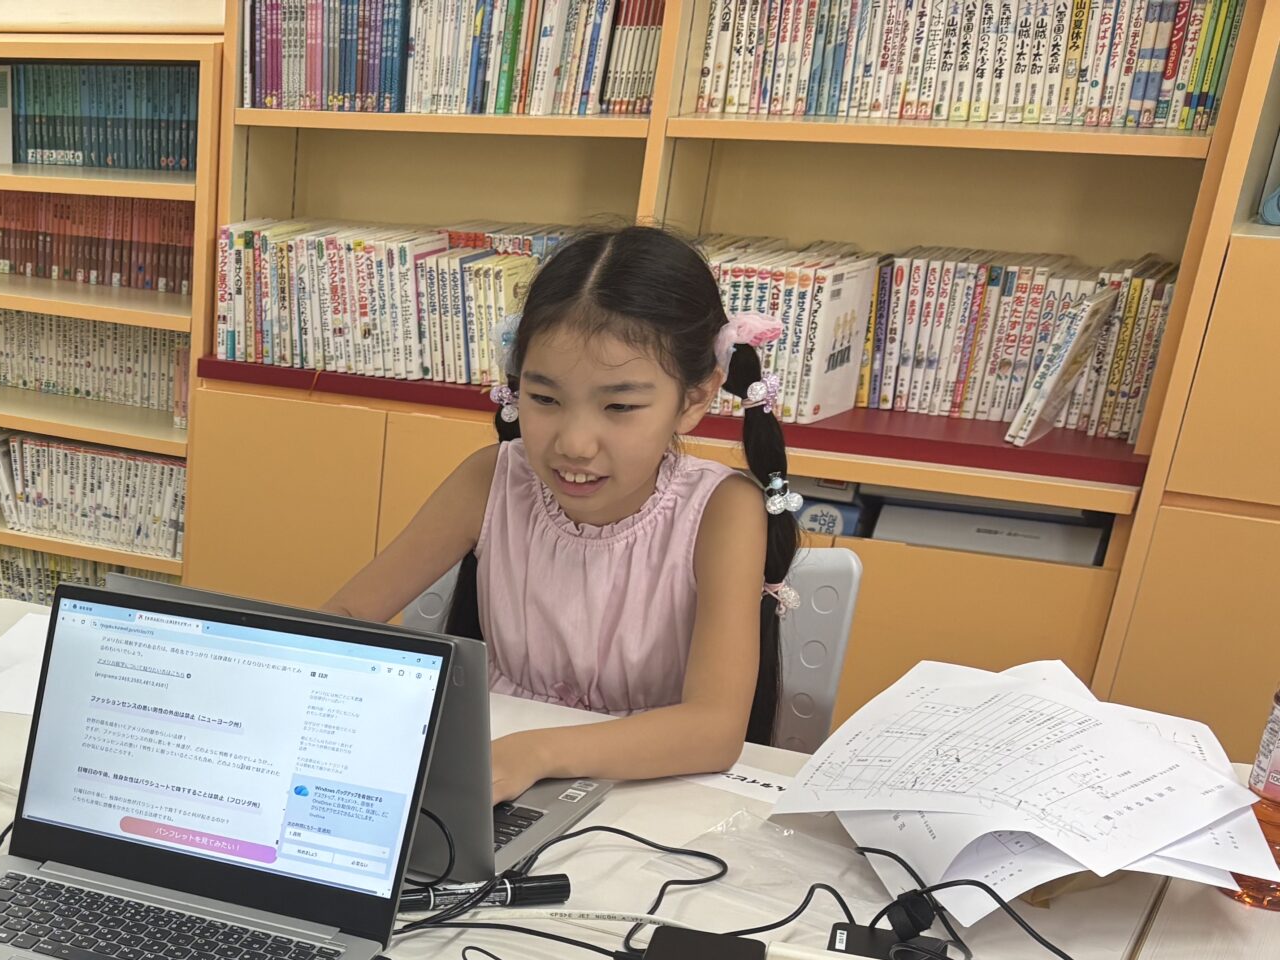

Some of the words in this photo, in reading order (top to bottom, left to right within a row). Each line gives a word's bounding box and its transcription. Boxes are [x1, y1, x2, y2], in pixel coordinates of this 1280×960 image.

[958, 2, 977, 72] 八雲国の大合戦
[976, 3, 994, 80] 気球にのった少年
[994, 3, 1012, 80] 気球にのった少年
[1014, 17, 1031, 74] 山賊小太郎
[1030, 17, 1048, 76] 山賊小太郎
[1048, 2, 1068, 74] 八雲国の大合戦
[1095, 12, 1112, 58] おばけ
[1183, 13, 1204, 58] おばけ
[1004, 282, 1028, 356] 母をたずねて
[1020, 283, 1044, 357] 母をたずねて
[154, 826, 241, 852] パンフレットを見てみたい！
